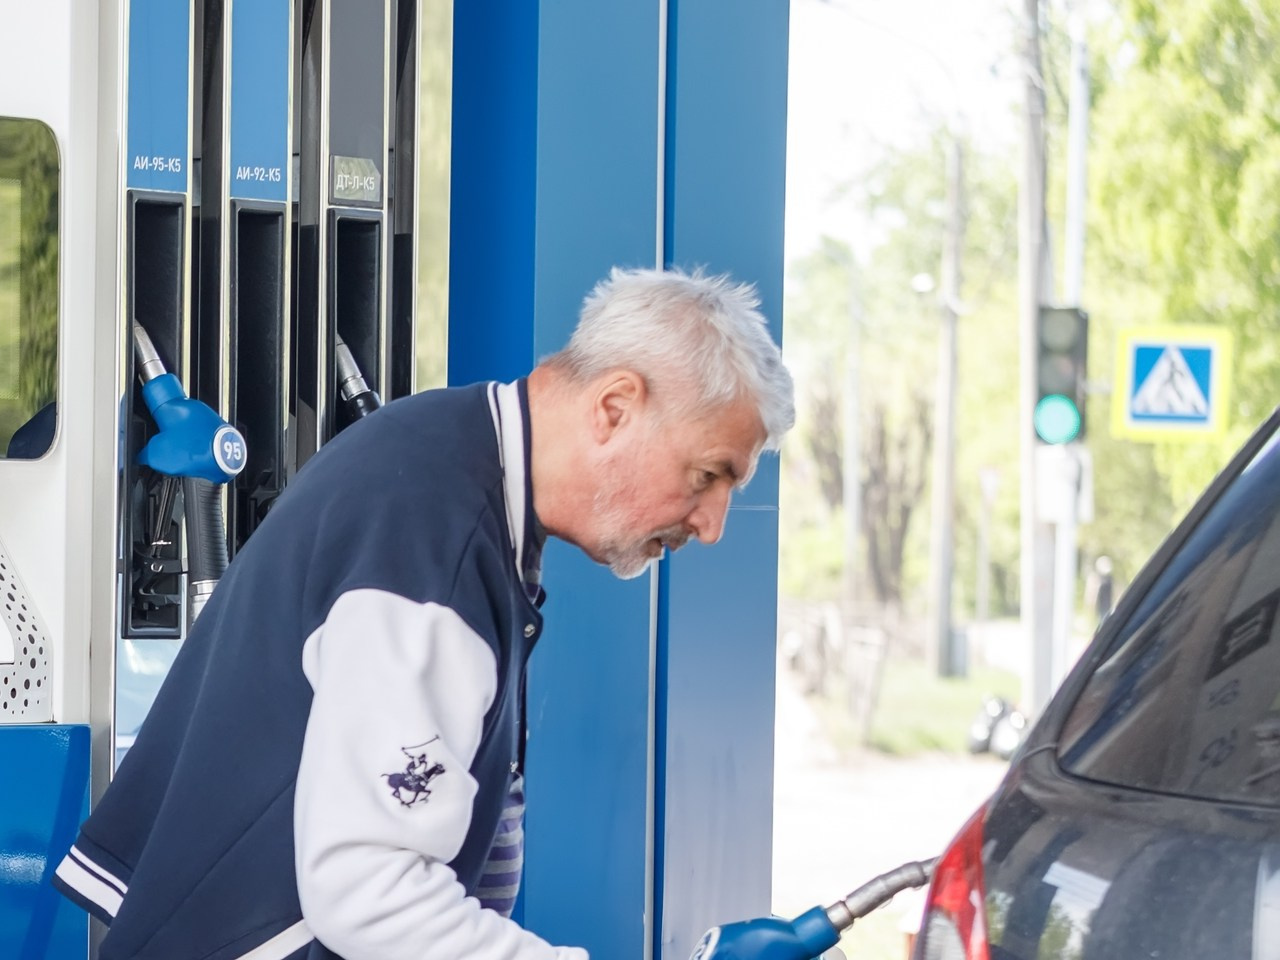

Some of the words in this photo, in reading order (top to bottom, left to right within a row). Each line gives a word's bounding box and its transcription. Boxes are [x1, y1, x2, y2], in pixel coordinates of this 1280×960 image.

[134, 155, 181, 173] АИ-95-К5
[236, 166, 281, 183] АИ-92-К5
[335, 174, 375, 191] ДТ-Л-К5
[223, 441, 242, 461] 95
